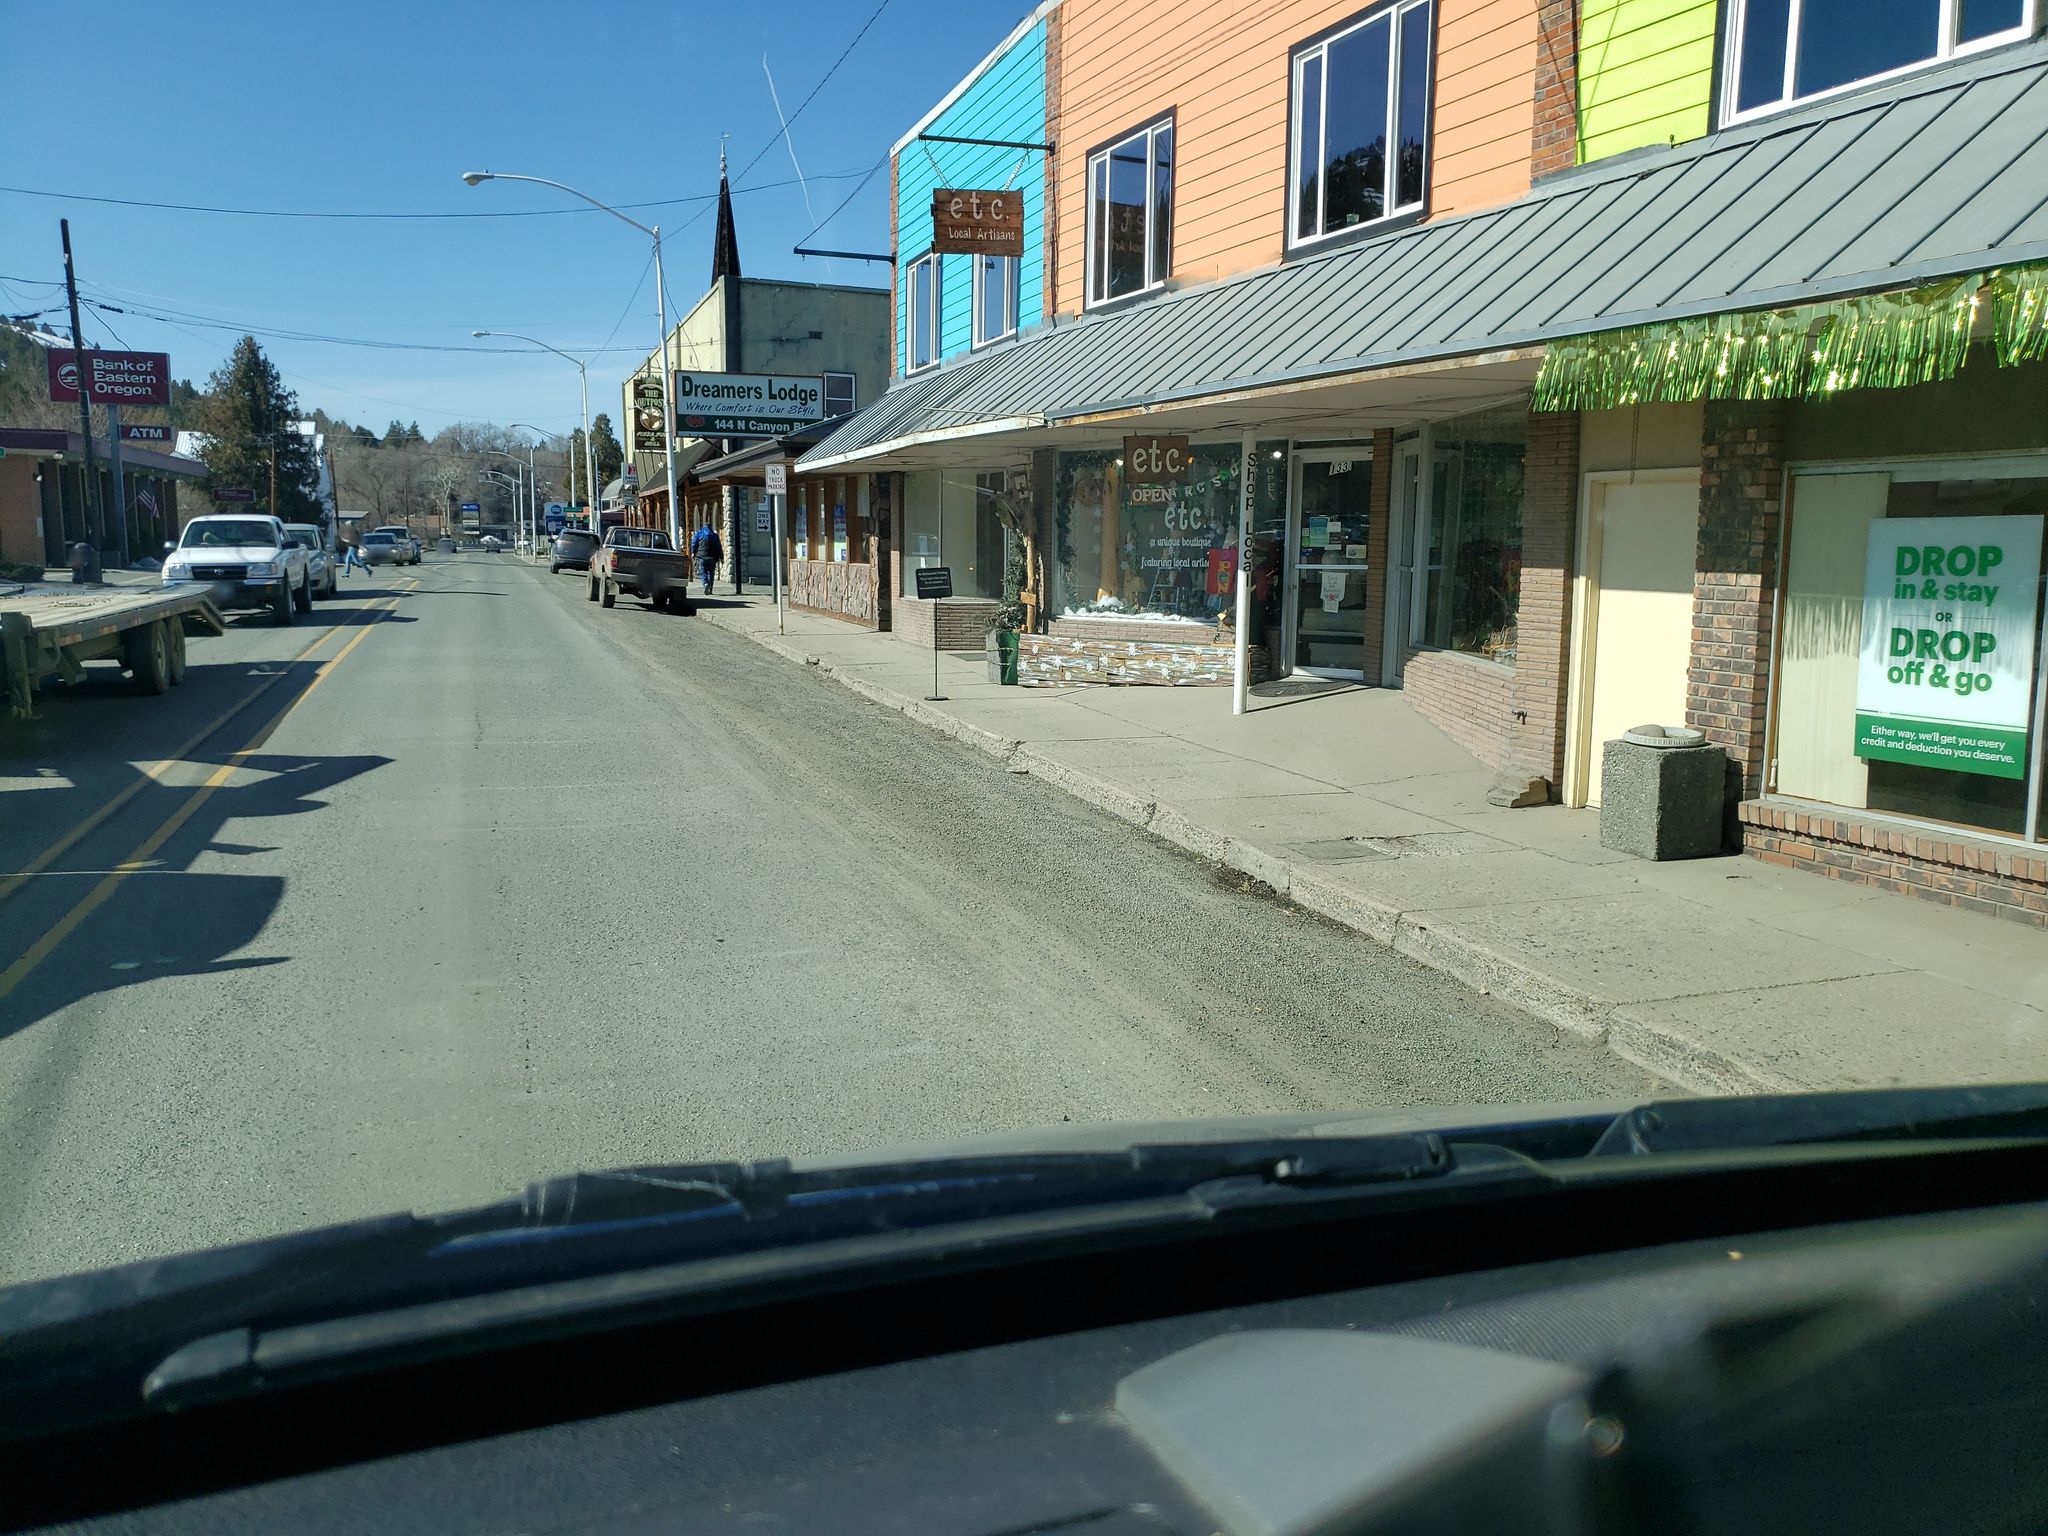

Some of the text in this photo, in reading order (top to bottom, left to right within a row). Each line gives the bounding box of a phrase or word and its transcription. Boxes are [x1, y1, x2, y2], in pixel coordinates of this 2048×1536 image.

[950, 191, 1010, 220] etc.
[948, 226, 1016, 241] Local Artisans
[92, 359, 154, 371] Bank of
[94, 371, 156, 384] Eastern
[95, 383, 152, 396] Oregon
[681, 375, 818, 406] Dreamers Lodge
[686, 402, 816, 416] Where Comfort is Our Style
[130, 428, 163, 438] ATM
[714, 418, 734, 430] 144
[738, 420, 746, 430] N
[748, 420, 790, 433] Canyon
[1132, 440, 1185, 473] etc.
[1331, 462, 1348, 474] 133
[1245, 452, 1257, 511] Shop
[1132, 488, 1173, 502] OPEN
[1164, 501, 1207, 530] etc.
[1157, 536, 1181, 550] unique
[1181, 536, 1212, 550] boutique
[1140, 556, 1172, 570] featuring
[1172, 557, 1190, 569] local
[1244, 521, 1254, 587] Local
[1895, 545, 2003, 577] DROP
[1894, 577, 2000, 607] in & stay
[1934, 611, 1953, 623] OR
[1889, 627, 1997, 663] DROP
[1887, 661, 1993, 696] off & go
[1870, 725, 2006, 751] Either way, we'll get you every
[1860, 735, 2016, 765] credit and deduction you deserve.
